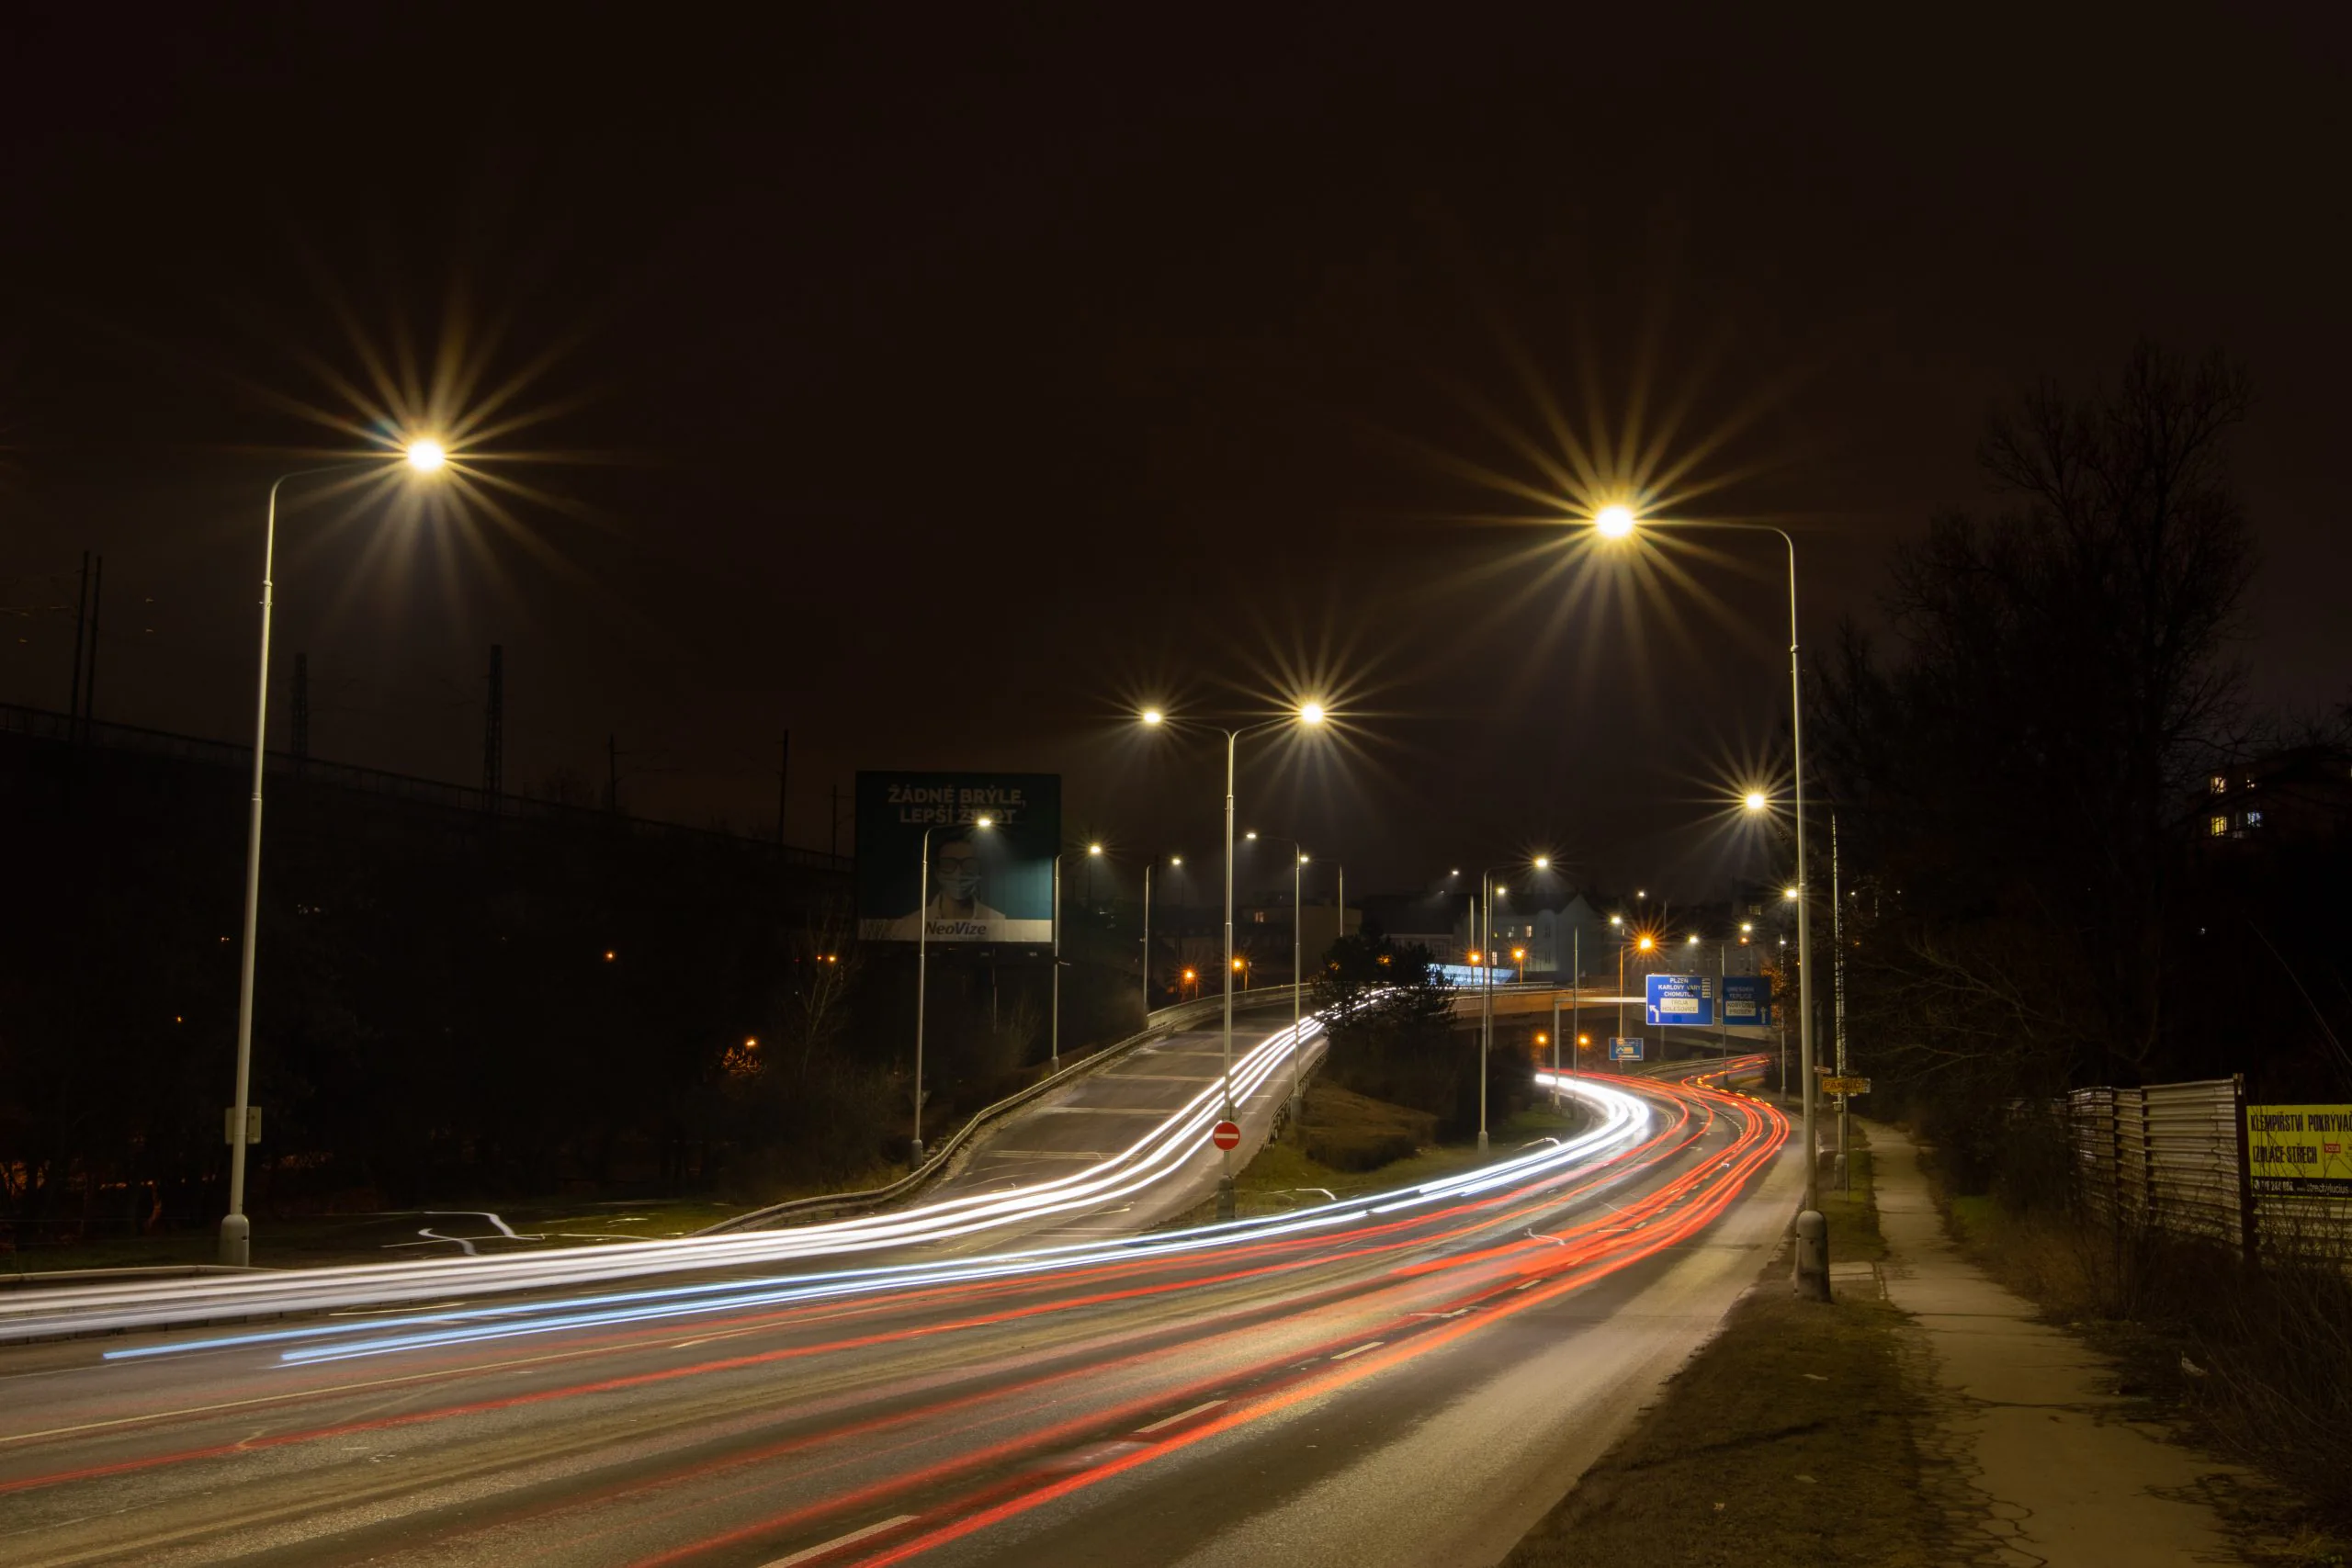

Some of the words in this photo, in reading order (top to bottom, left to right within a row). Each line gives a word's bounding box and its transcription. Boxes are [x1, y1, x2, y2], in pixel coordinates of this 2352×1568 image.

[888, 783, 956, 804] ŽÁDNÉ
[960, 783, 1026, 808] BRÝLE,
[899, 804, 954, 824] LEPŠÍ
[924, 921, 988, 935] NeoVize
[2253, 1145, 2285, 1163] IZOLACE
[2287, 1143, 2318, 1164] STŘECH
